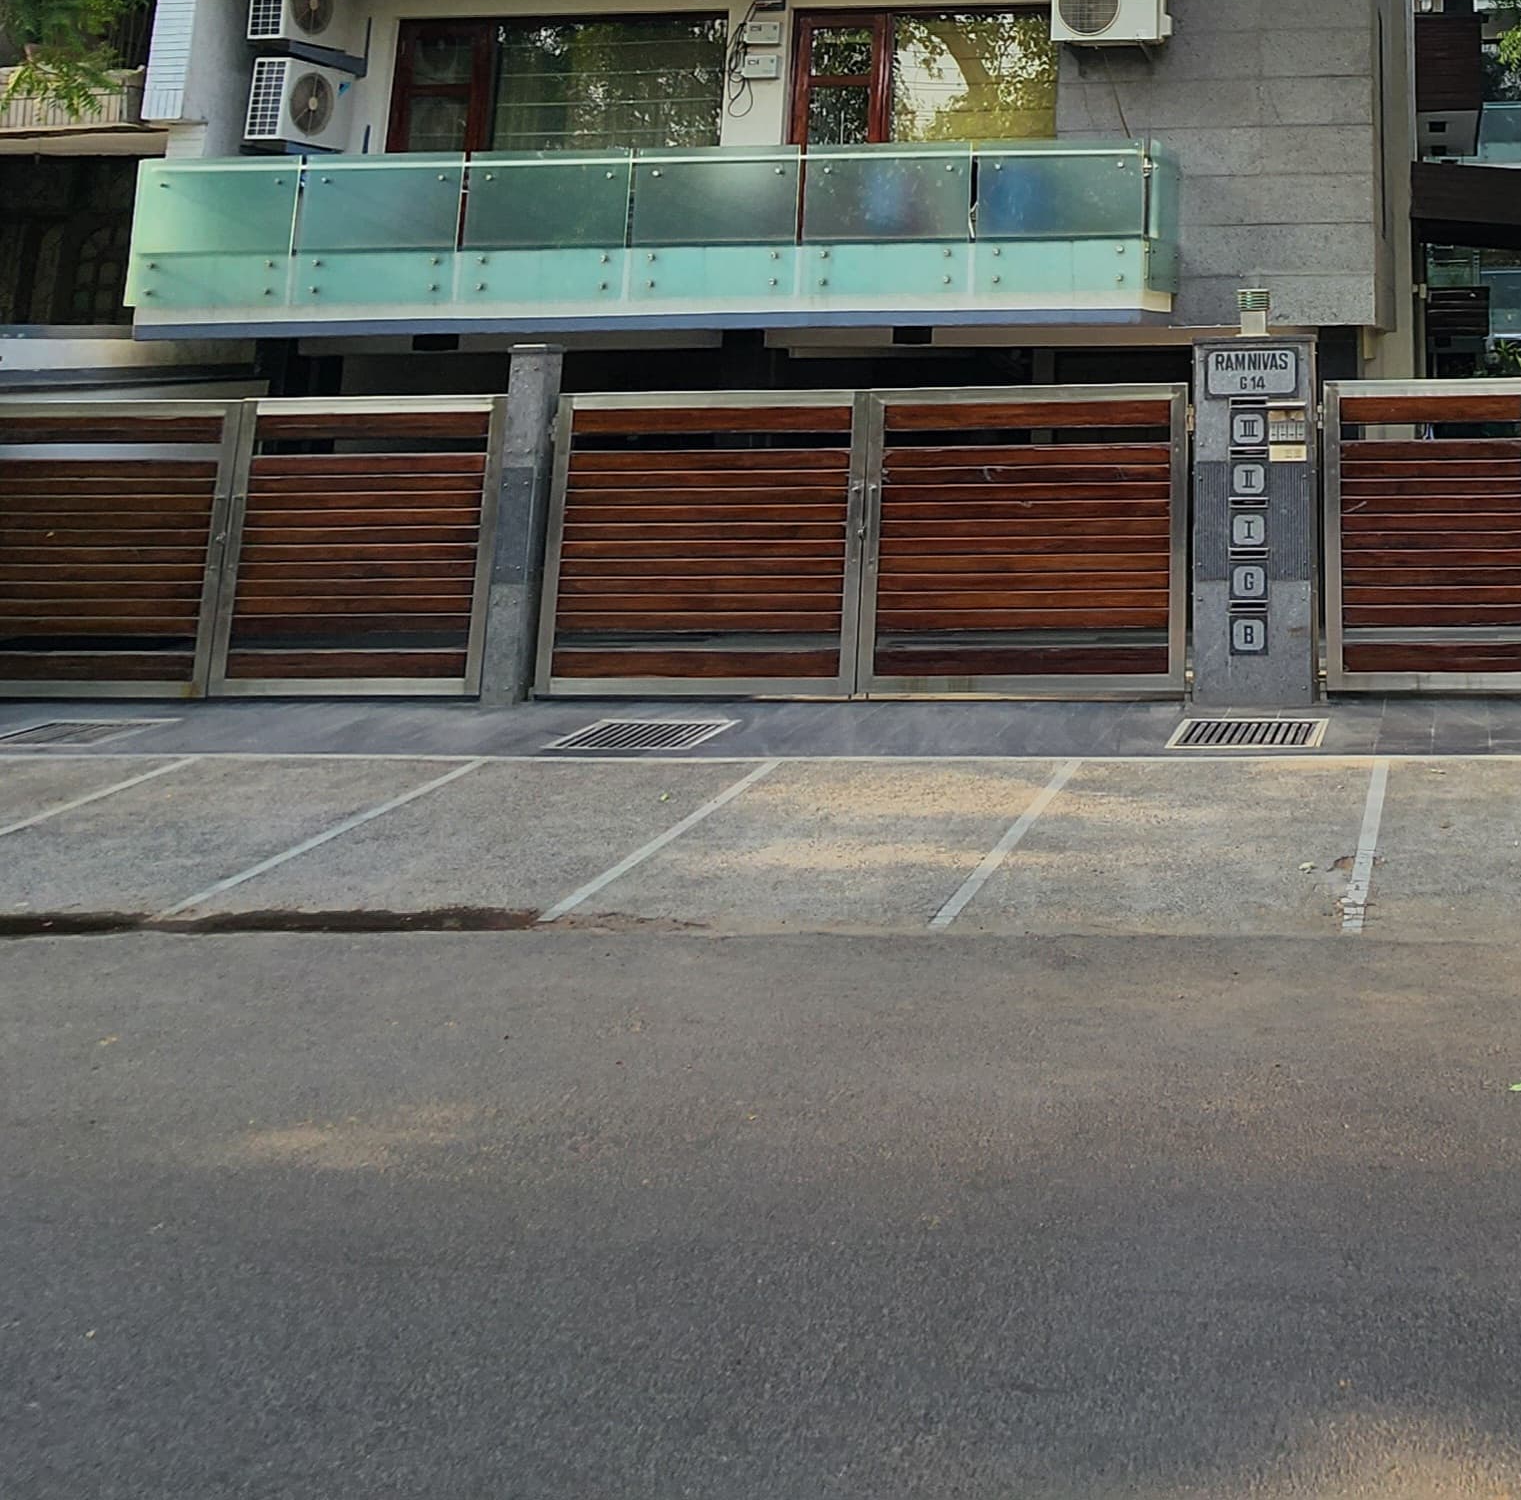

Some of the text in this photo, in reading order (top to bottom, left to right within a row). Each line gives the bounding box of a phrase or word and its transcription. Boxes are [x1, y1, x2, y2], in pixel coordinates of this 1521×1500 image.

[1239, 376, 1266, 390] G 14
[1239, 419, 1259, 438] III
[1242, 469, 1256, 489] II
[1244, 520, 1255, 539] I
[1244, 572, 1254, 591] G
[1244, 625, 1254, 645] B
